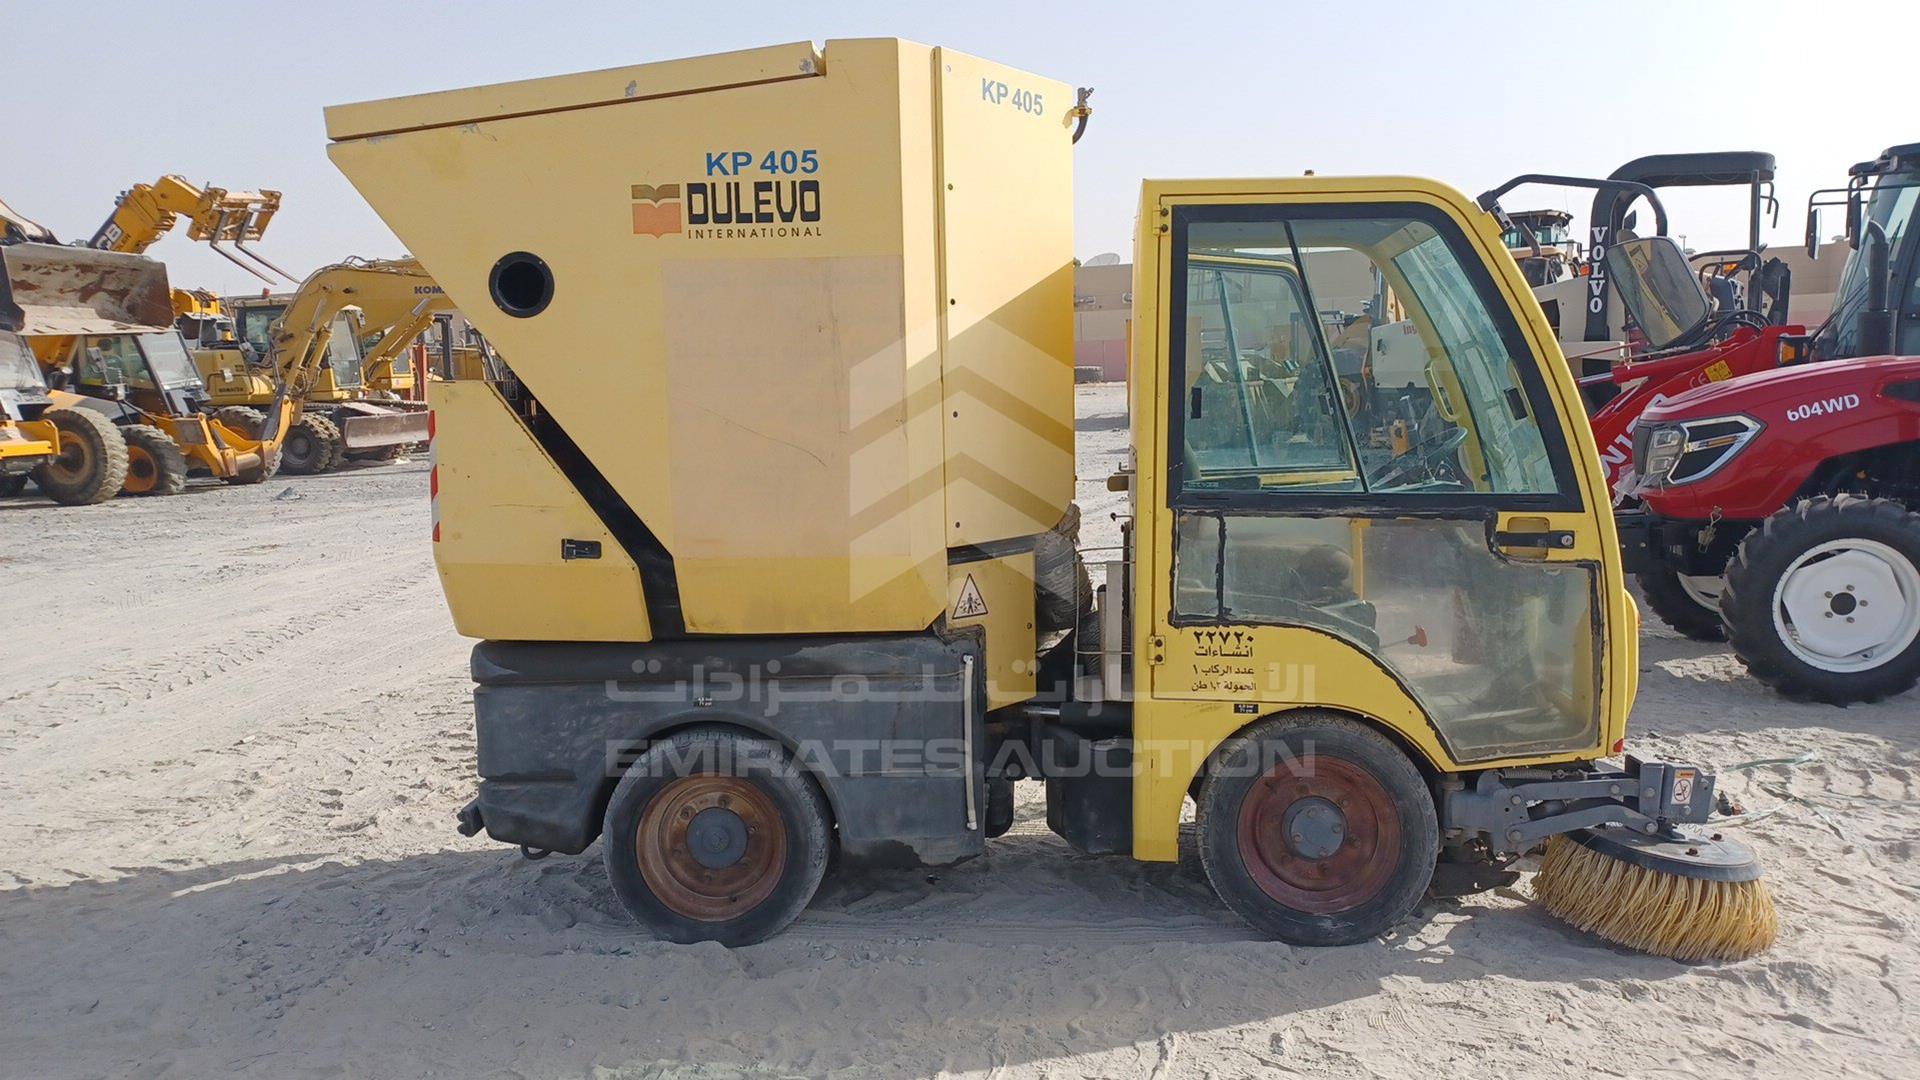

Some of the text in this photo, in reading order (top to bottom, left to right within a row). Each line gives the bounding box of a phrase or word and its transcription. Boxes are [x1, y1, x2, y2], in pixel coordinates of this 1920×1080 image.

[982, 78, 1043, 116] KP 405
[706, 150, 819, 176] KP 405
[687, 180, 821, 225] DULEVO
[688, 227, 822, 239] INTERNATIONAL
[1589, 226, 1608, 313] VOLVO
[414, 286, 445, 294] KOM
[1787, 394, 1860, 421] 604WD
